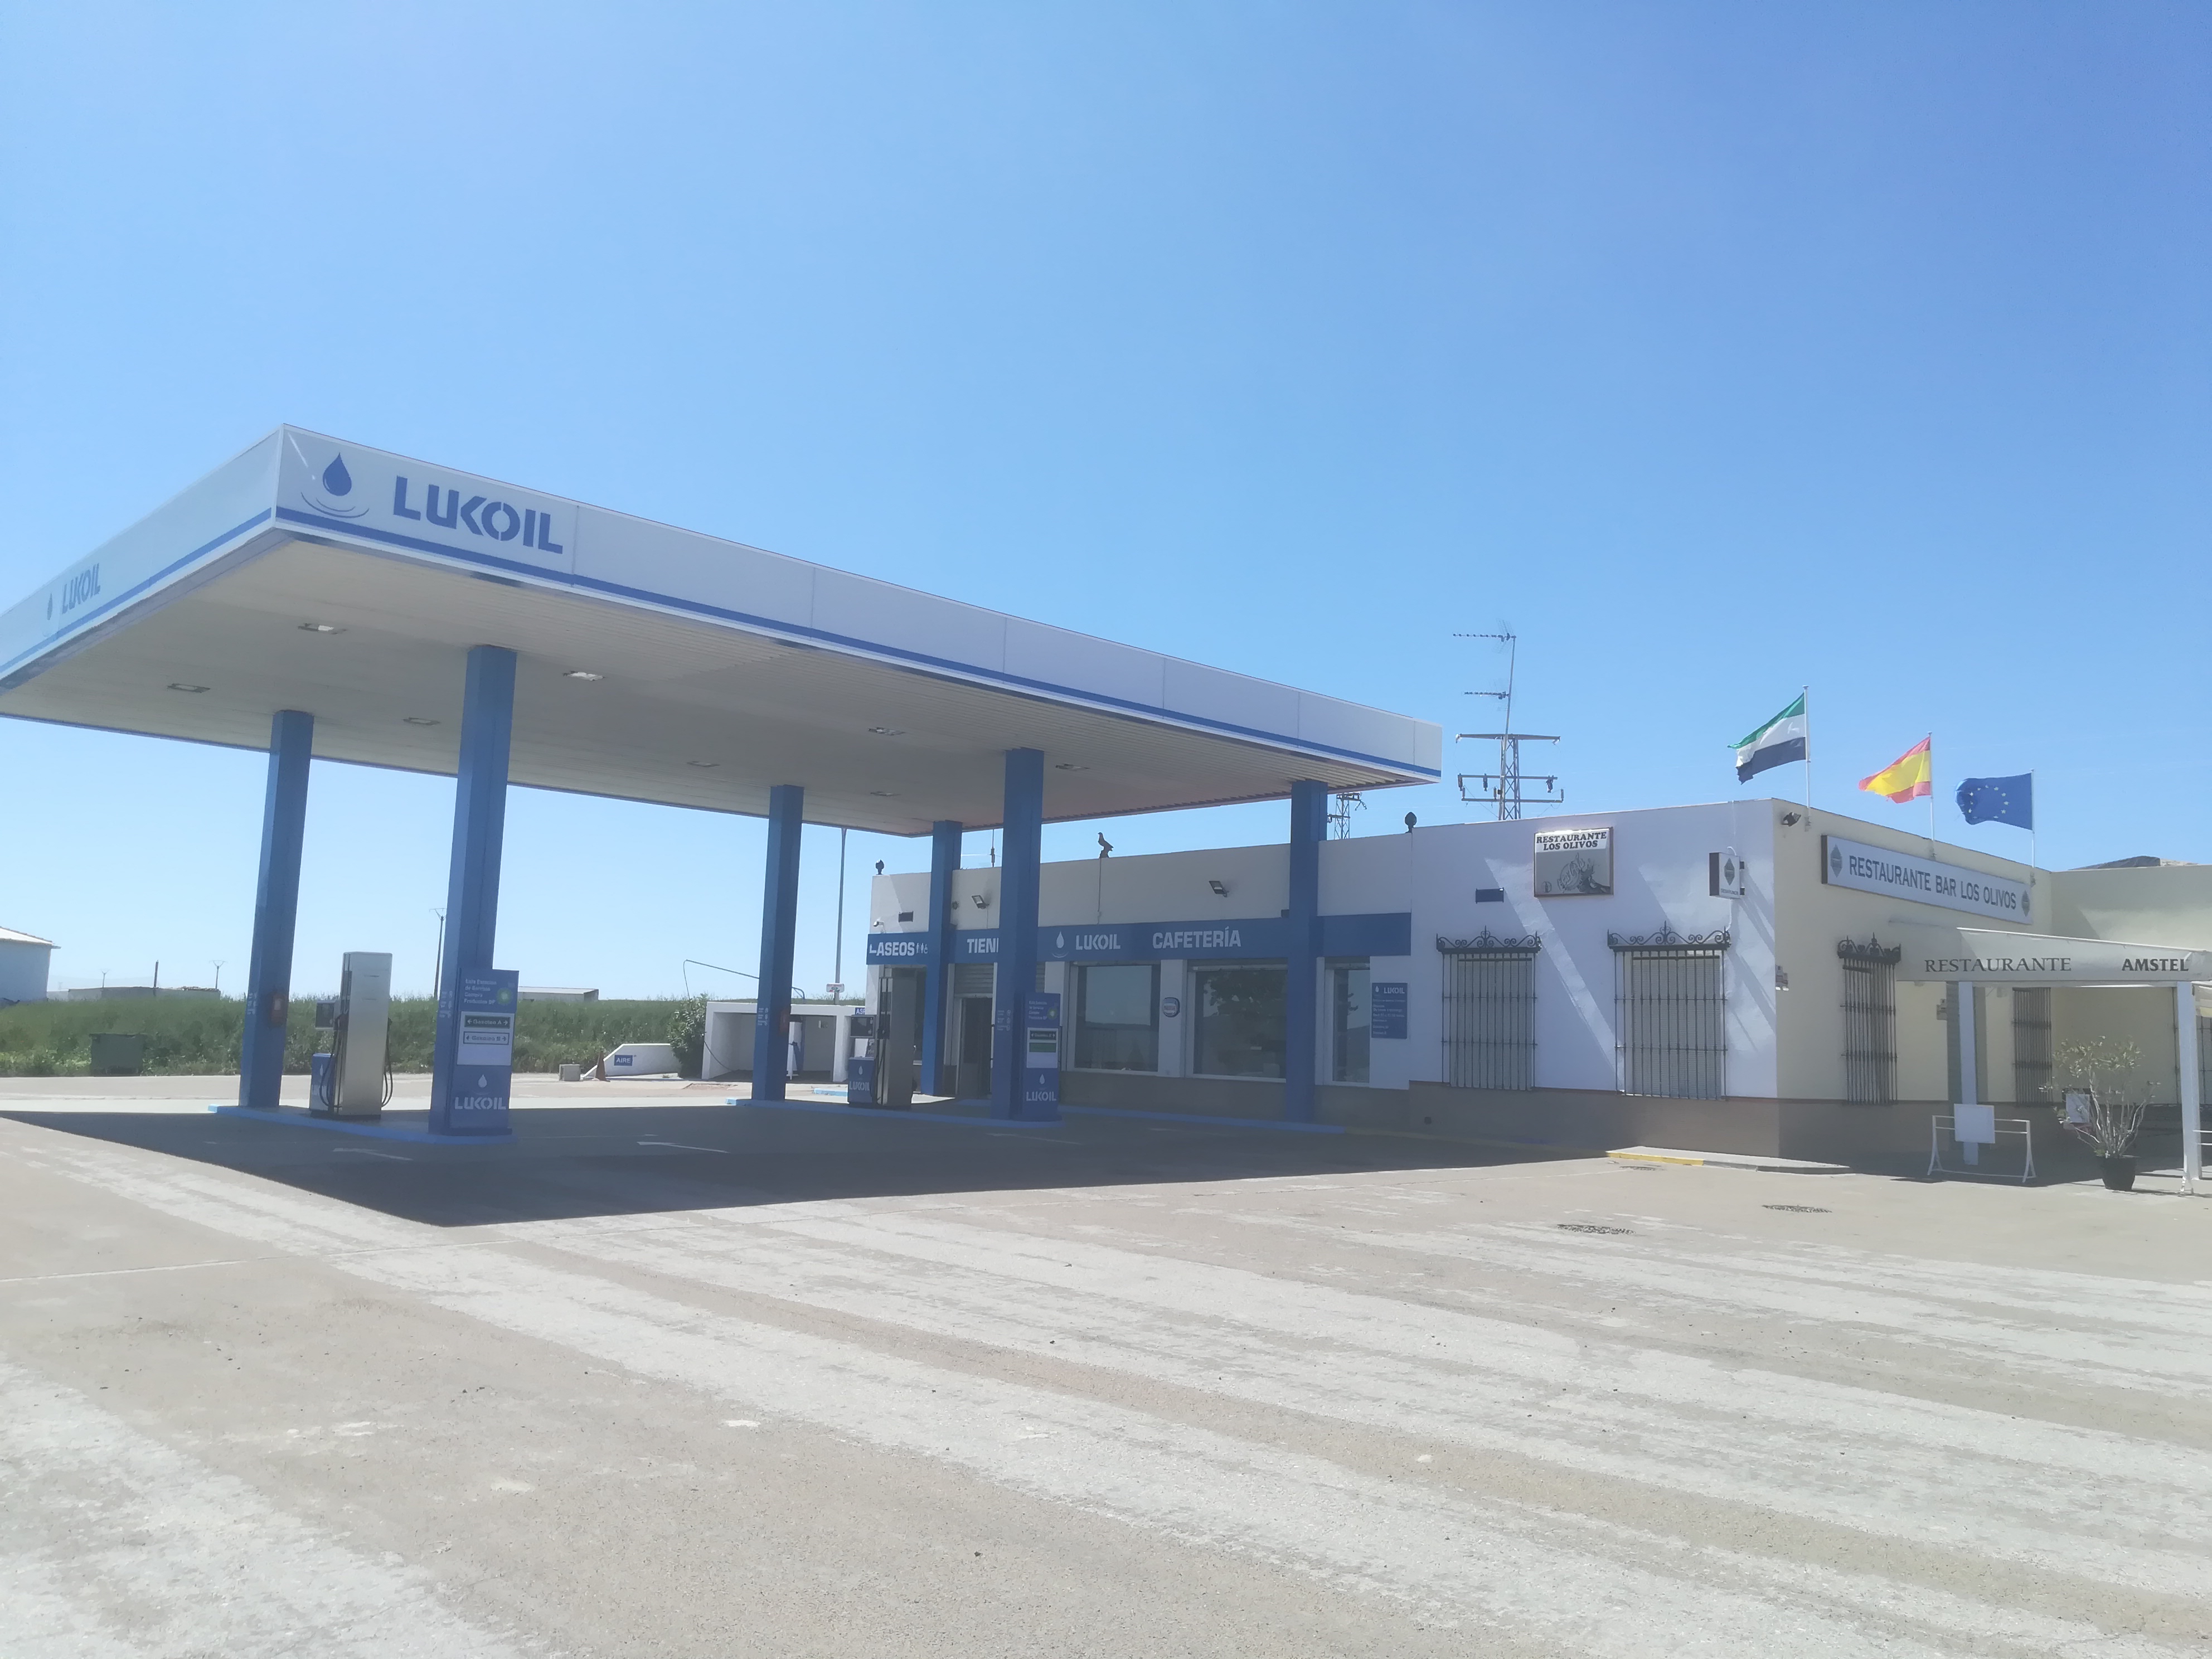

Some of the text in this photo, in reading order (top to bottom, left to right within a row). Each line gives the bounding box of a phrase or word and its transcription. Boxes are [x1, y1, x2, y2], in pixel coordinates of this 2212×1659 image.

[393, 475, 563, 554] LUKOIL
[62, 562, 100, 614] LUKOIL
[1536, 832, 1607, 843] RESTAURANTE
[1563, 840, 1598, 849] OLIVOS
[1849, 855, 2016, 910] RESTAURANTE BAR LOS OLIVOS
[1075, 934, 1121, 950] LUKOIL
[1153, 926, 1241, 949] CAFETERÍA
[967, 937, 999, 953] TIEN
[1924, 958, 2072, 972] RESTAURANTE
[2122, 958, 2189, 972] AMSTEL
[849, 1081, 870, 1091] LUKOIL
[454, 1097, 506, 1110] LUKOIL
[1026, 1091, 1057, 1102] LUKOIL
